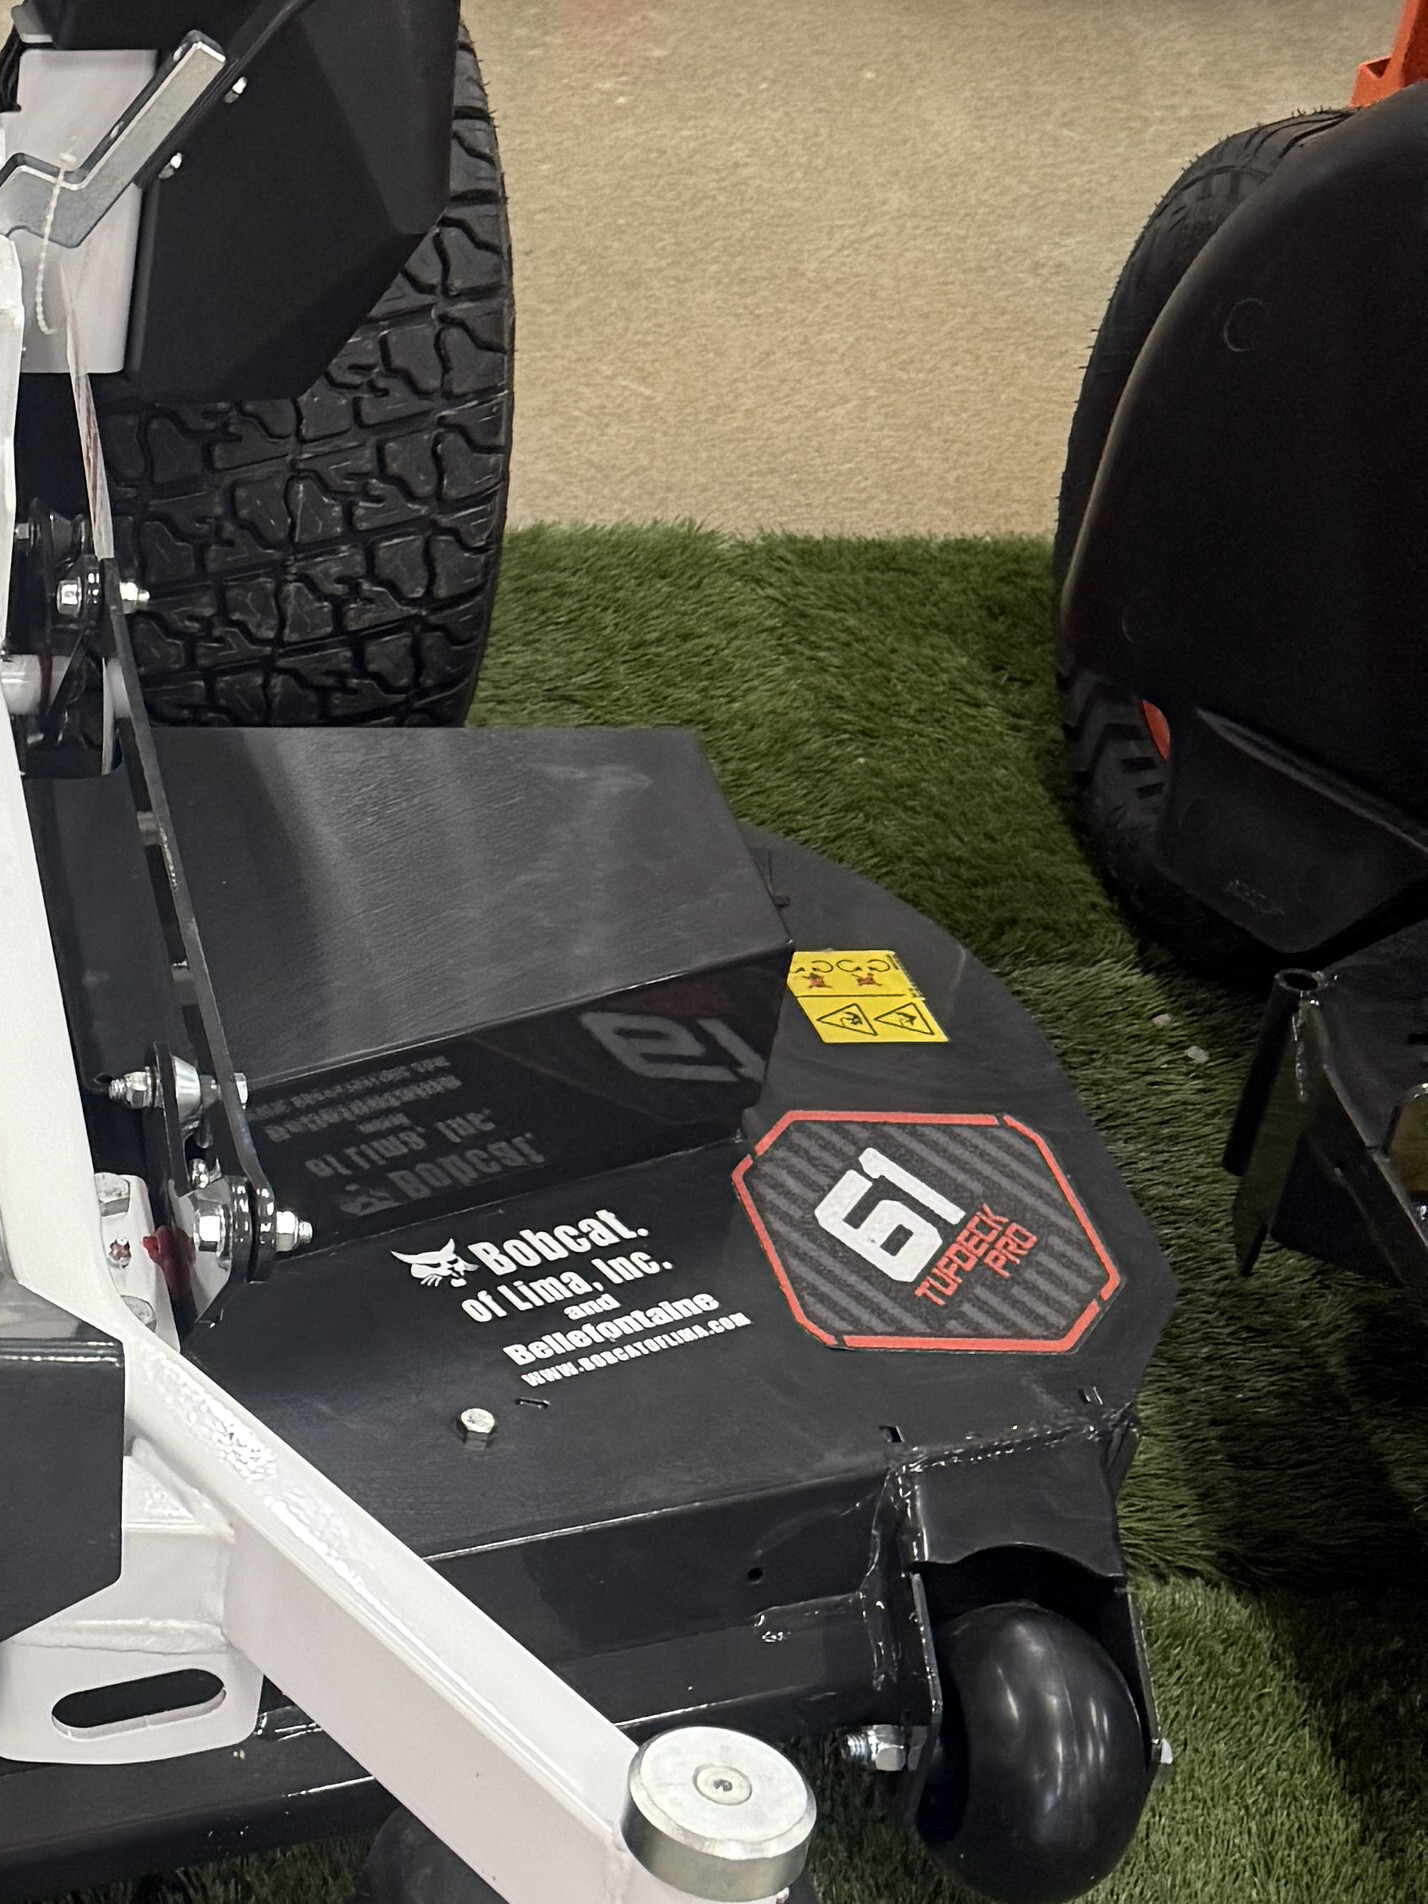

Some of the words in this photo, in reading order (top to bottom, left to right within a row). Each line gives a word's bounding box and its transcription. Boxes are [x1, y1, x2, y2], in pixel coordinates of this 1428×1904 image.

[814, 1147, 966, 1283] 61
[983, 1222, 1038, 1279] PRO
[461, 1290, 507, 1322] of
[497, 1271, 604, 1312] Lima,
[591, 1250, 673, 1285] Inc.
[915, 1203, 1010, 1306] TUFDECK
[502, 1293, 720, 1366] Bellefontaine
[563, 1293, 621, 1320] and
[521, 1312, 752, 1387] WWW.BOBCATOFLIMA.COM
